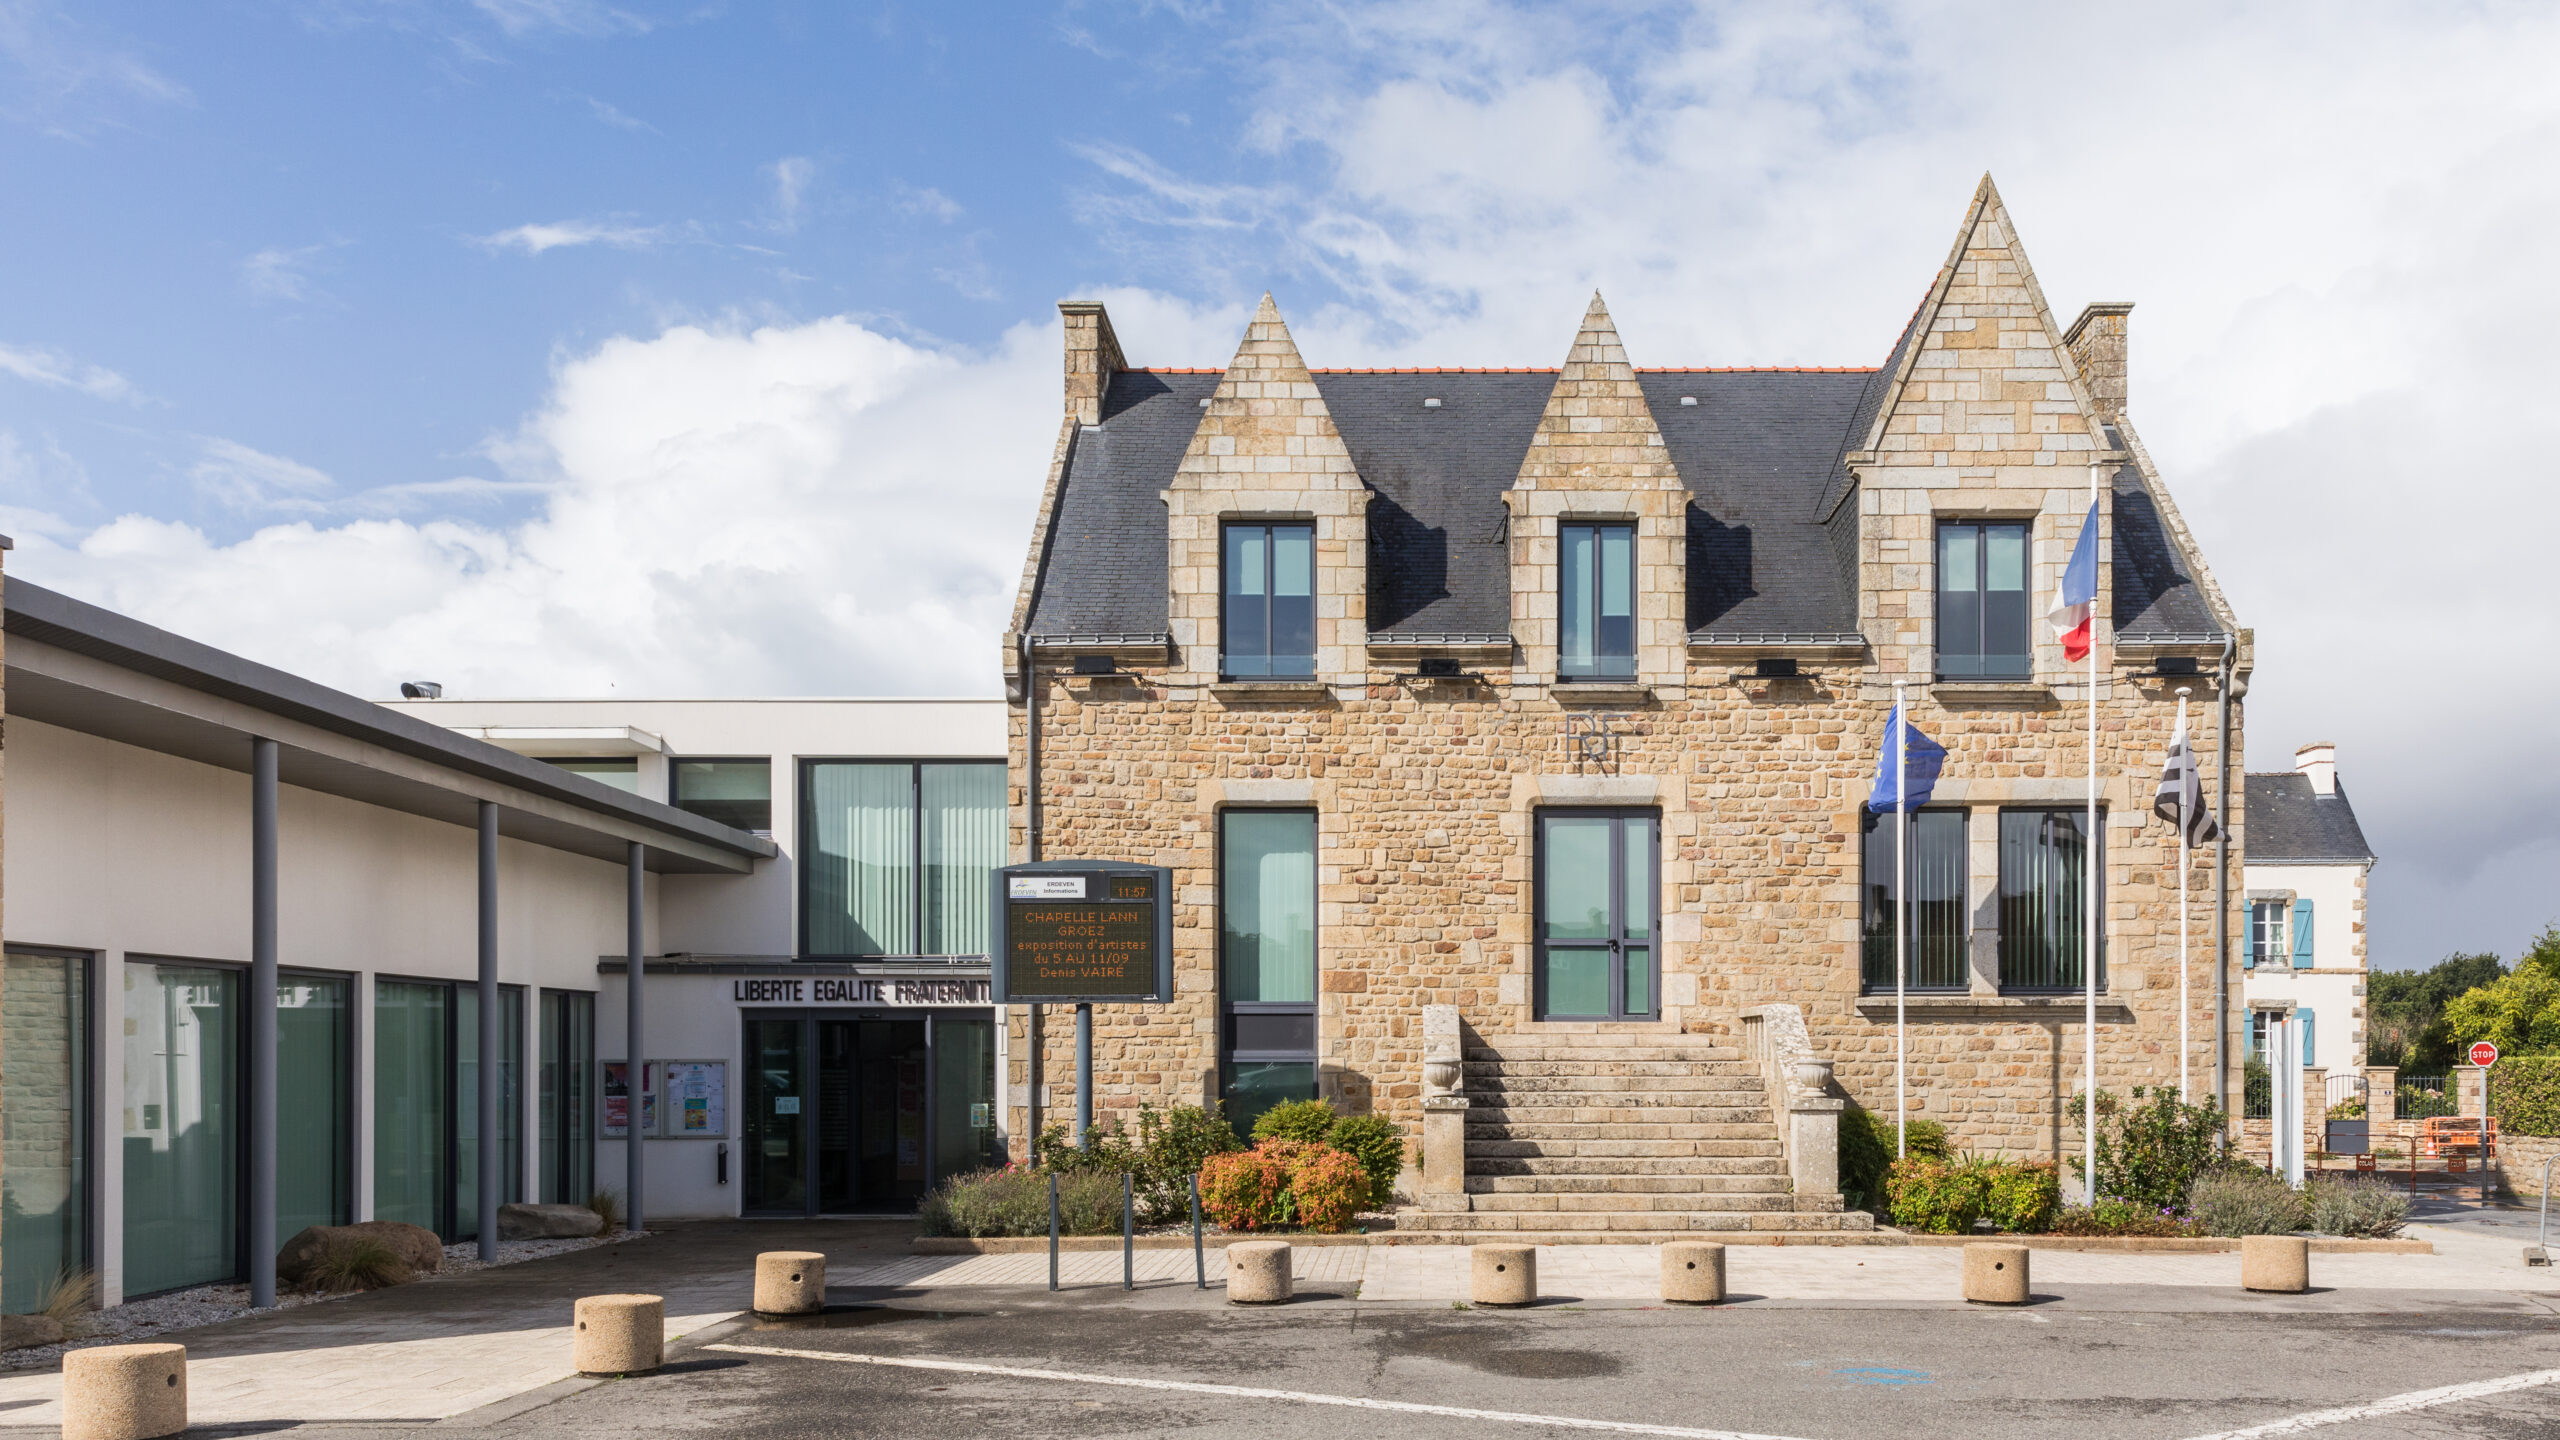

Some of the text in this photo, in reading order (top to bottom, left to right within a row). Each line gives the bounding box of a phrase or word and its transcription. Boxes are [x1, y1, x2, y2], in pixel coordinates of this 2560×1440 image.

[1119, 887, 1146, 898] 11:57
[1025, 911, 1139, 923] CHAPELLE LANN
[1058, 925, 1105, 936] GROEZ
[1018, 938, 1147, 952] exposition d'artistes
[1034, 952, 1129, 965] du 5 AU 11/09
[1040, 964, 1124, 978] Denis VAIRÉ
[734, 980, 803, 1001] LIBERTE
[813, 980, 884, 1001] EGALITE
[2472, 1051, 2494, 1059] STOP
